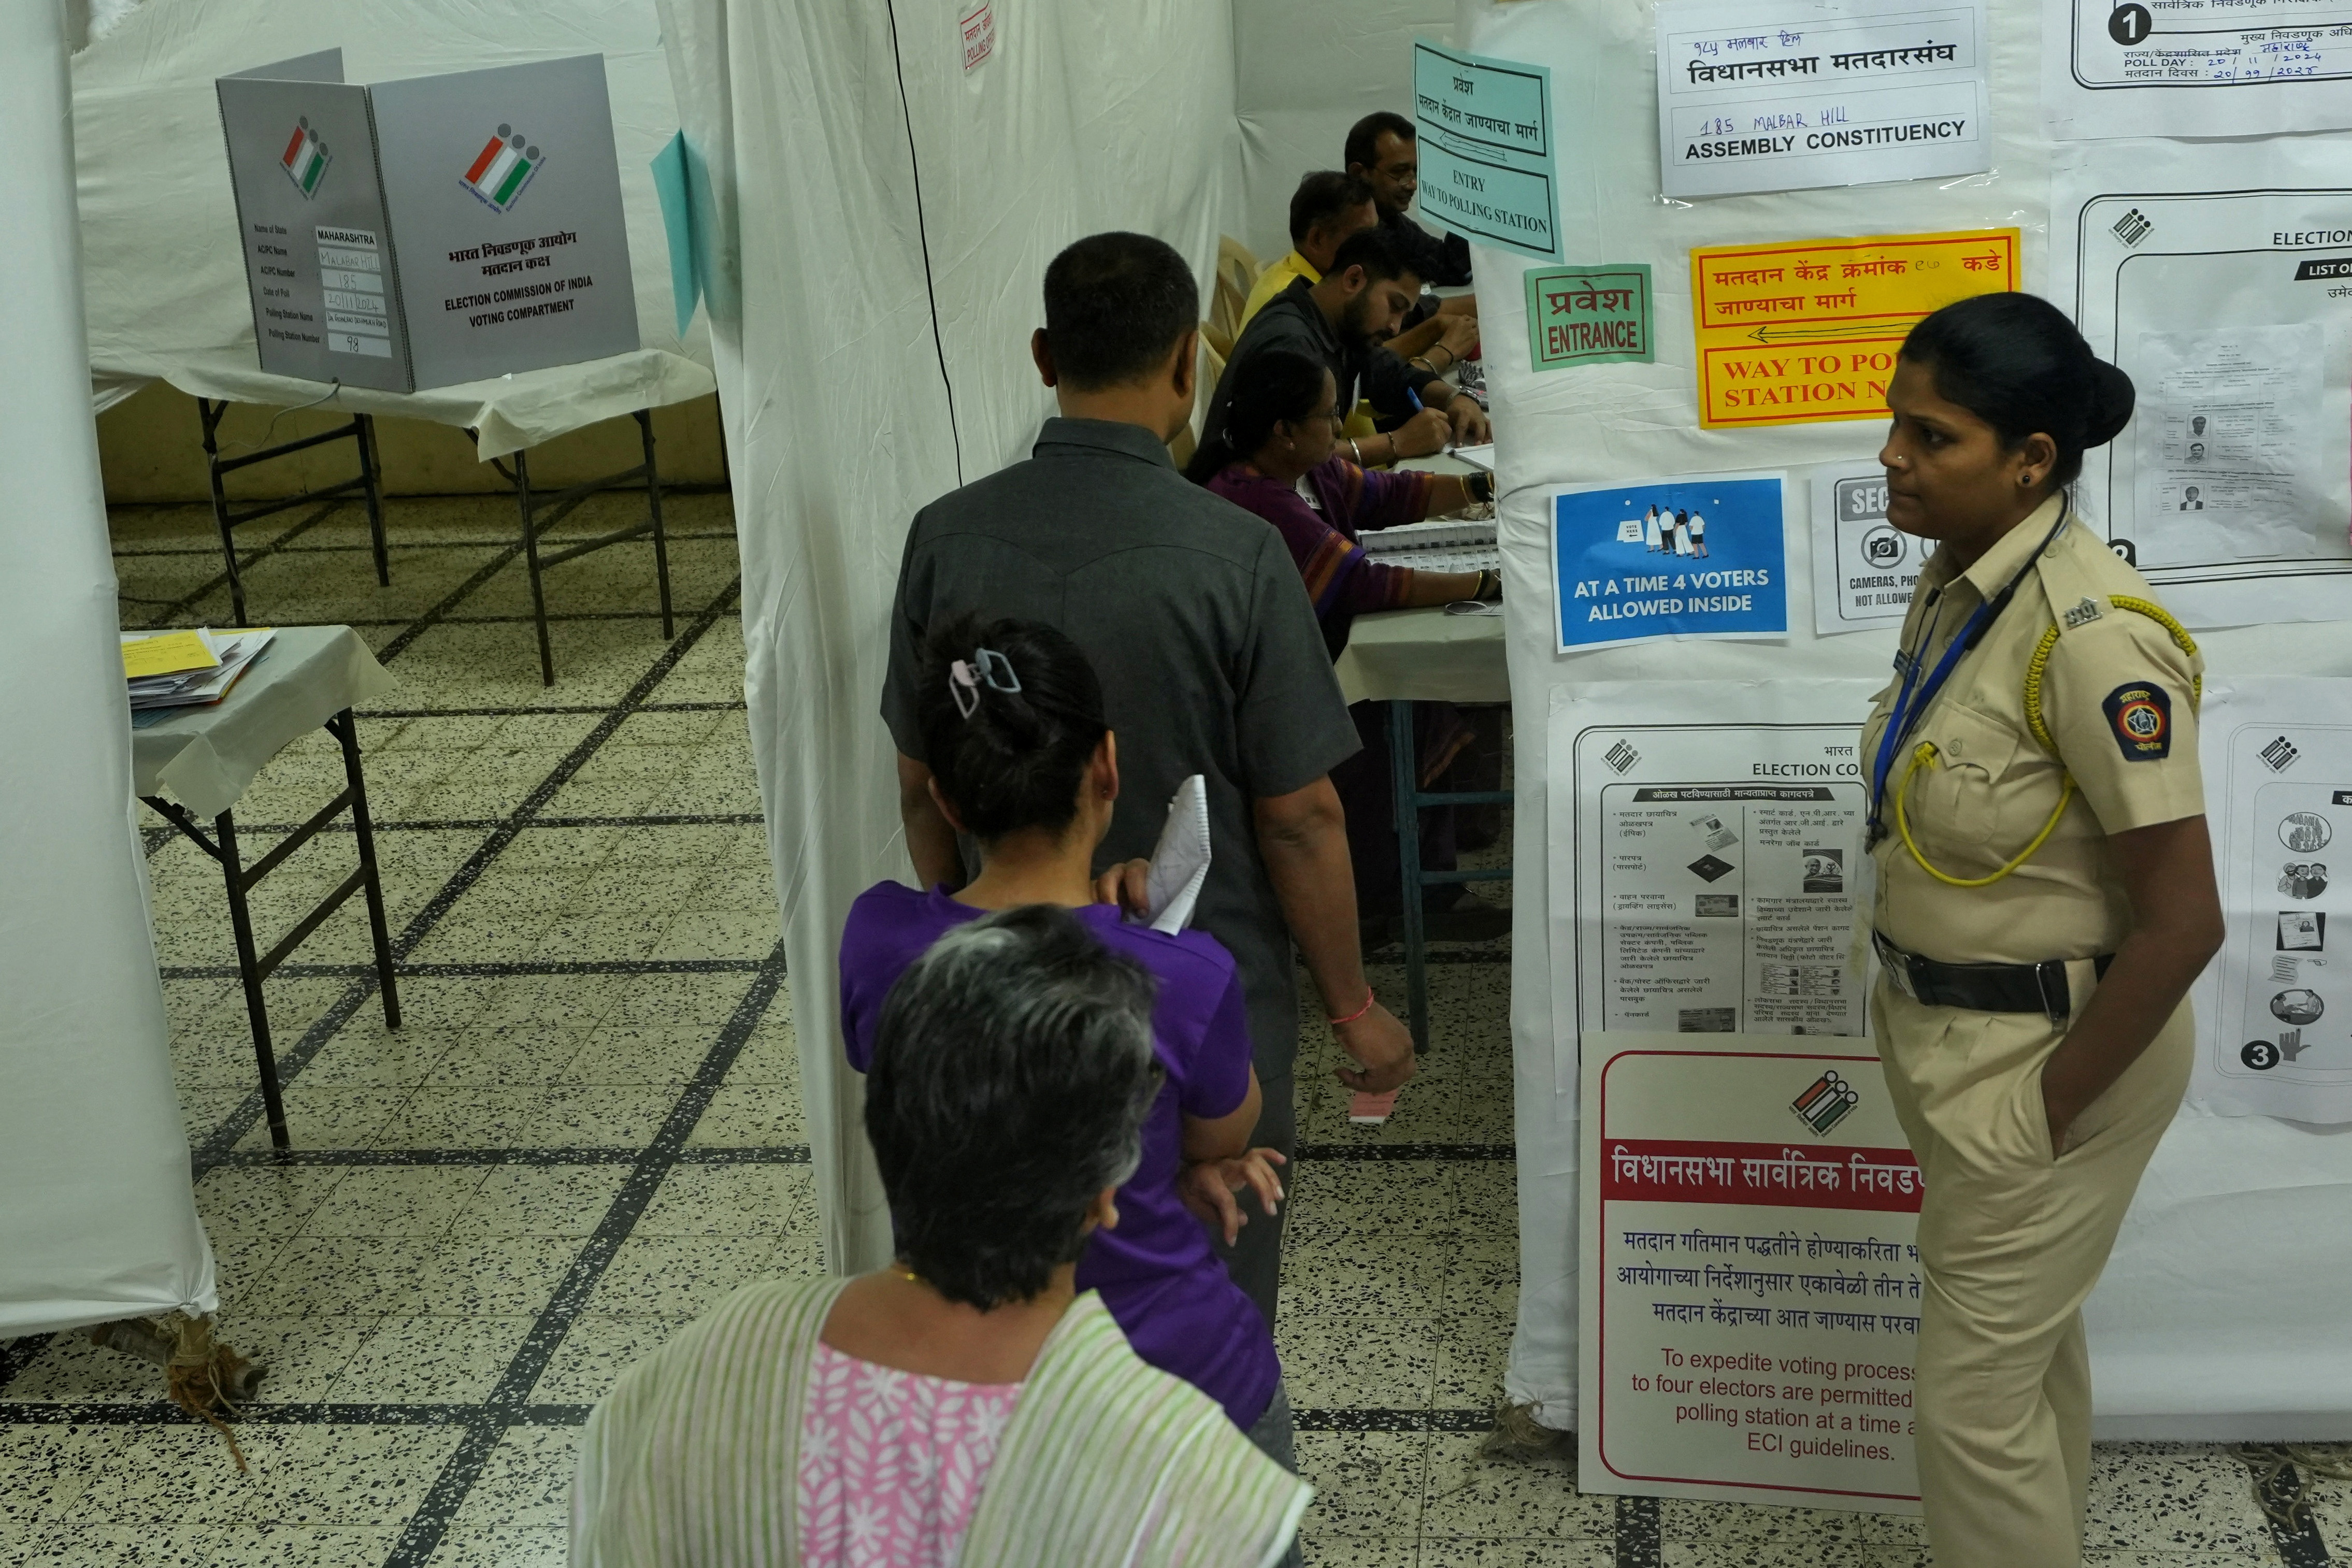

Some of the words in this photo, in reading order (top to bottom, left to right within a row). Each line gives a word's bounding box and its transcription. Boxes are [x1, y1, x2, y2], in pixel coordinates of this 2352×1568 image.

[2122, 10, 2136, 38] 1
[1726, 36, 1768, 50] मलबार
[1777, 30, 1804, 47] हिल
[2241, 33, 2265, 45] मुख्य
[2271, 30, 2324, 42] निवडणूक
[967, 39, 986, 62] POLLING
[1686, 56, 1820, 84] विधानसभा
[1830, 40, 1957, 70] मतदारसंघ
[2125, 59, 2157, 67] POLL
[2161, 58, 2187, 66] DAY
[1453, 73, 1473, 95] प्रवेश
[2125, 69, 2162, 78] मतदान
[2169, 68, 2198, 77] दिवस
[1418, 94, 1439, 114] मतदान
[1442, 98, 1461, 123] केंद्रात
[1465, 112, 1510, 135] जाण्याचा
[1515, 120, 1538, 141] मार्ग
[1700, 118, 1734, 136] 185
[1754, 113, 1808, 131] MALBAR
[1820, 106, 1849, 126] HILL
[1685, 136, 1795, 160] ASSEMBLY
[1806, 120, 1966, 149] CONSTITUENCY
[1453, 169, 1485, 192] ENTRY
[1422, 180, 1436, 199] WAY
[1437, 188, 1447, 204] TO
[1449, 193, 1492, 220] POLLING
[1495, 208, 1547, 234] STATION
[254, 224, 268, 233] Name
[275, 225, 286, 234] State
[318, 230, 375, 244] MAHARASHTRA
[274, 246, 287, 255] Name
[449, 248, 480, 263] भारत
[481, 239, 536, 258] निवडणूक
[538, 231, 577, 248] आयोग
[321, 251, 359, 268] MALABAR
[481, 260, 523, 276] मतदान
[525, 255, 551, 269] कक्ष
[1713, 268, 1784, 287] मतदान
[1794, 260, 1831, 281] केंद्र
[1840, 255, 1908, 278] क्रमांक
[1961, 249, 2002, 271] कडे
[2309, 264, 2336, 276] LIST
[277, 268, 295, 277] Number
[339, 274, 356, 289] 185
[263, 286, 274, 296] Date
[275, 287, 279, 296] of
[280, 289, 290, 297] Poll
[445, 292, 491, 311] ELECTION
[494, 282, 552, 303] COMMISSION
[554, 280, 566, 292] OF
[568, 275, 593, 290] INDIA
[1545, 280, 1634, 315] प्रवेश
[1713, 296, 1805, 316] जाण्याचा
[1815, 287, 1857, 309] मार्ग
[266, 308, 282, 319] Polling
[283, 309, 299, 320] Station
[300, 312, 313, 321] Name
[469, 312, 505, 327] VOTING
[507, 299, 575, 321] COMPARTMENT
[269, 328, 284, 340] Polling
[285, 330, 300, 341] Station
[302, 333, 320, 343] Number
[347, 336, 358, 352] 98
[1548, 320, 1637, 354] ENTRANCE
[1723, 357, 1794, 380] WAY
[1798, 355, 1841, 374] TO
[1725, 382, 1856, 408] STATION
[1574, 581, 1599, 598] AT
[1603, 579, 1620, 596] A
[1623, 575, 1668, 594] TIME
[1673, 574, 1686, 591] 4
[1690, 569, 1769, 589] VOTERS
[1850, 576, 1898, 589] CAMERAS,
[1588, 599, 1683, 622] ALLOWED
[1688, 594, 1752, 613] INSIDE
[1856, 595, 1873, 607] NOT
[1824, 746, 1853, 756] भारत
[1753, 763, 1830, 776] ELECTION
[1836, 763, 1862, 776] CO
[1653, 789, 1678, 799] ओळख
[1681, 788, 1731, 798] पटविण्यासाठी
[1780, 788, 1814, 798] कागदपत्रे
[2252, 1045, 2269, 1065] 3
[1611, 1144, 1736, 1187] विधानसभा
[1740, 1147, 1843, 1191] सार्वत्रिक
[1623, 1232, 1676, 1253] मतदान
[1680, 1228, 1740, 1254] गतिमान
[1744, 1231, 1802, 1257] पद्धतीने
[1805, 1232, 1901, 1262] होण्याकरिता
[1616, 1260, 1701, 1287] आयोगाच्या
[1704, 1263, 1795, 1298] निर्देशानुसार
[1798, 1269, 1869, 1296] एकावेळी
[1873, 1272, 1904, 1298] तीन
[1908, 1273, 1921, 1299] ते
[1652, 1303, 1705, 1324] मतदान
[1709, 1298, 1771, 1327] केंद्राच्या
[1776, 1310, 1810, 1328] आत
[1814, 1311, 1876, 1332] जाण्यास
[1661, 1348, 1683, 1367] To
[1690, 1352, 1772, 1373] expedite
[1779, 1357, 1837, 1380] voting
[1632, 1374, 1650, 1391] to
[1656, 1374, 1694, 1393] four
[1700, 1377, 1775, 1399] electors
[1783, 1385, 1813, 1401] are
[1821, 1387, 1912, 1408] permitted
[1676, 1403, 1738, 1427] polling
[1745, 1406, 1808, 1427] station
[1816, 1412, 1834, 1430] at
[1841, 1417, 1852, 1431] a
[1859, 1414, 1901, 1434] time
[1748, 1432, 1782, 1452] ECI
[1790, 1437, 1895, 1461] guidelines.
